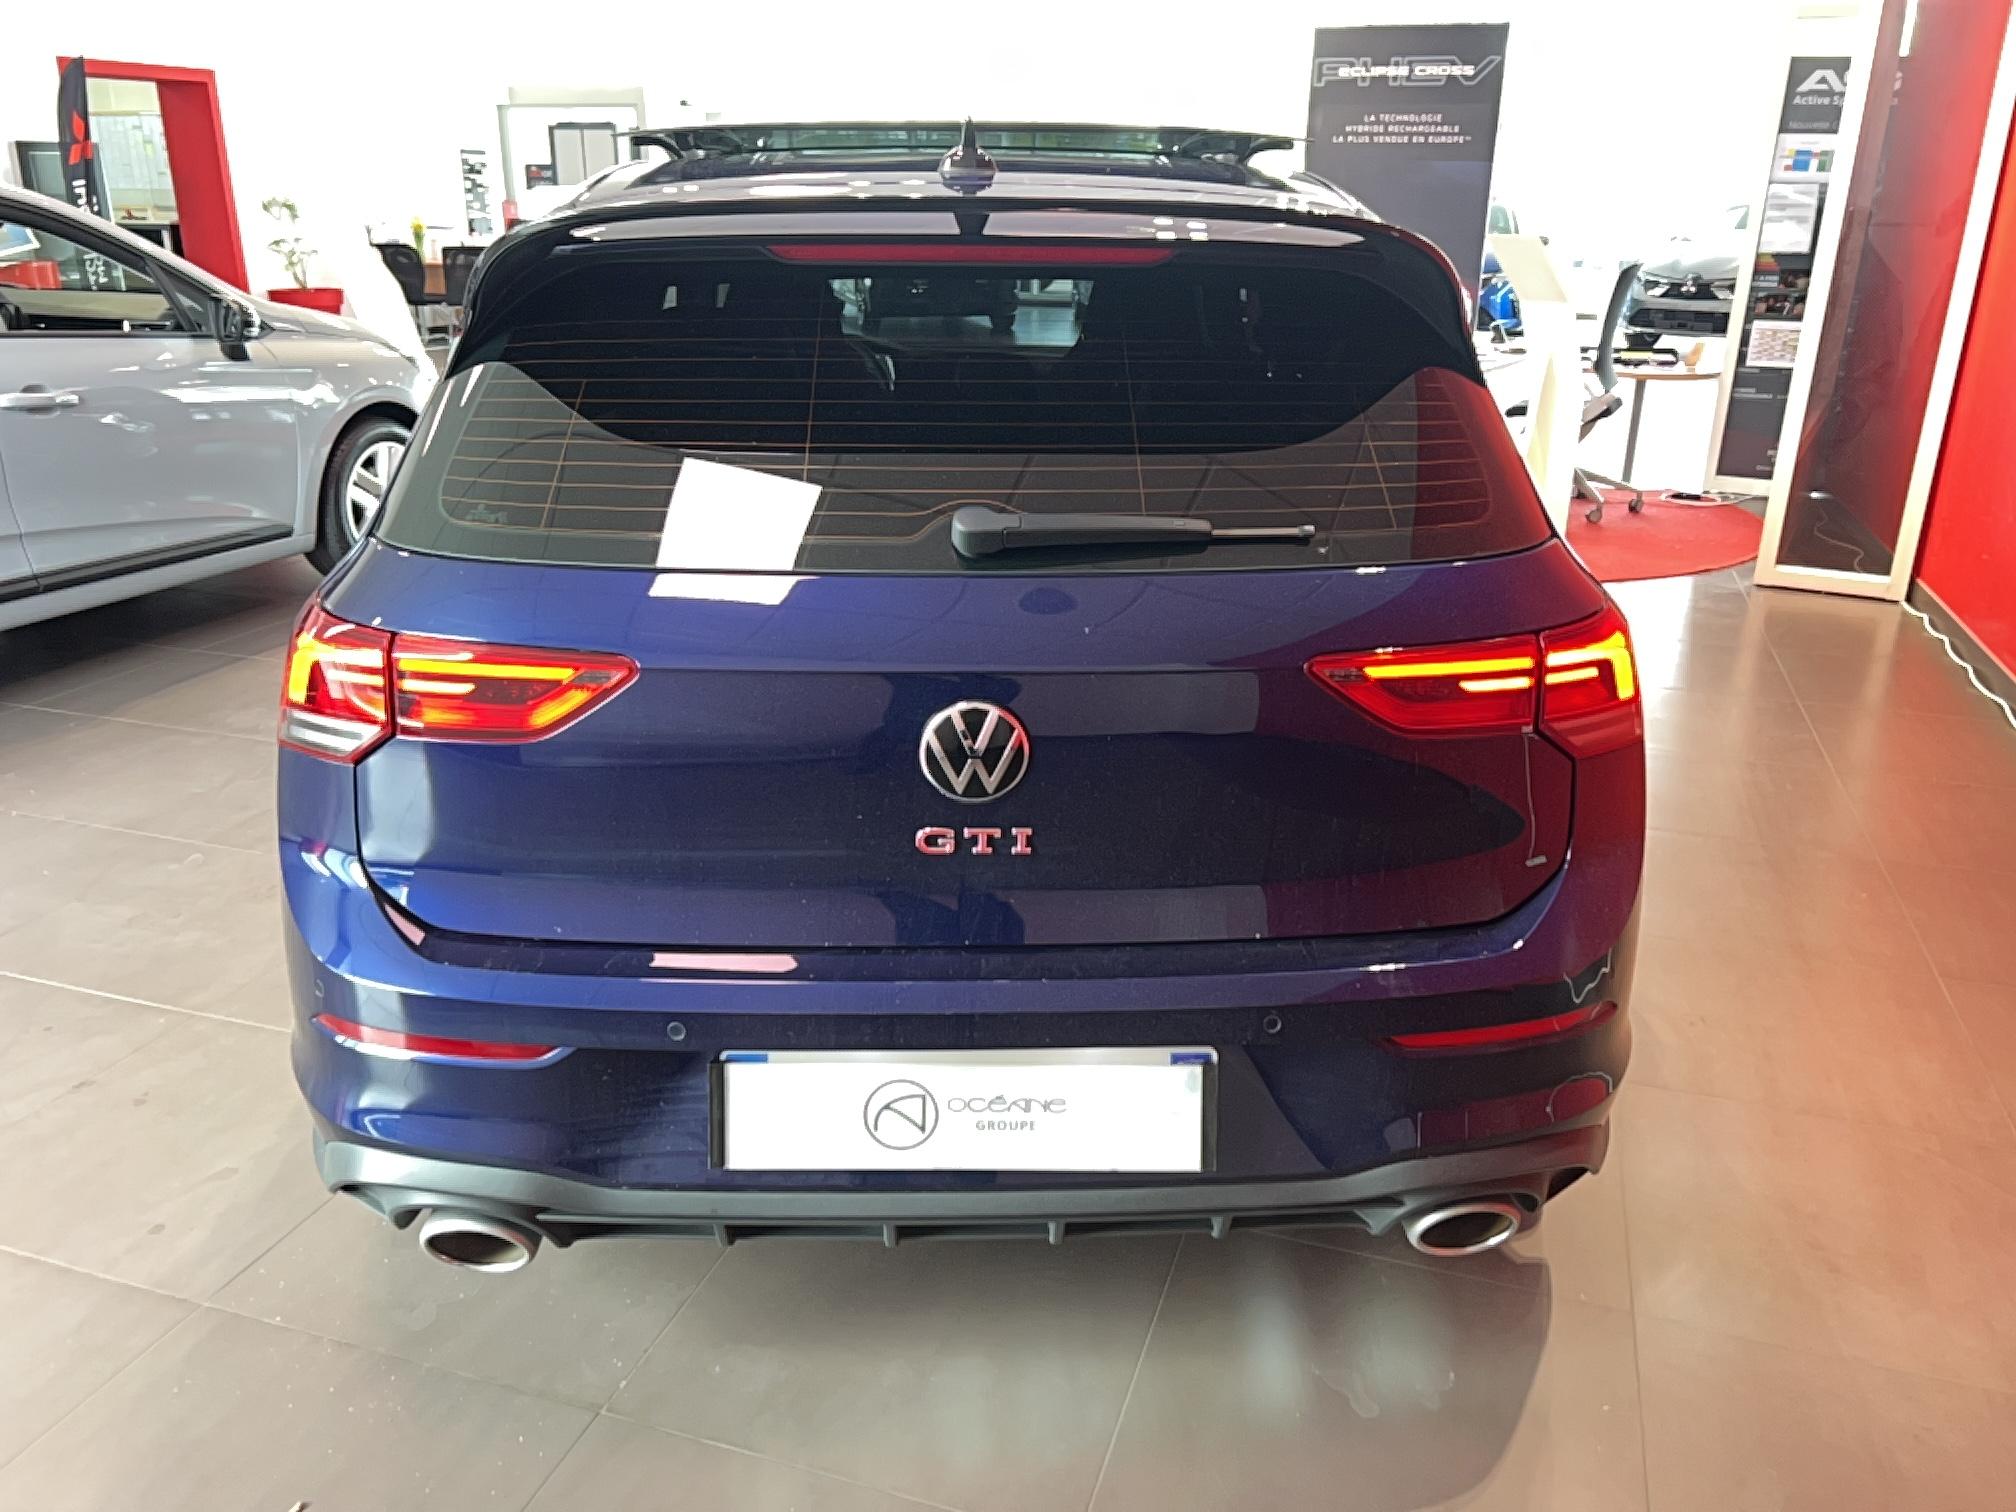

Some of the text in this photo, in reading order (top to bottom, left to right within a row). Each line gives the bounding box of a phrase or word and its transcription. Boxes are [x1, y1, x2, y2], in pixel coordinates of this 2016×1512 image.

[1313, 55, 1502, 87] PHEV
[1338, 64, 1476, 78] ECLIPSE CROSS
[1795, 68, 1847, 93] A
[1793, 95, 1830, 105] Active
[1363, 113, 1442, 122] LA TECHNOLOGIE
[1345, 124, 1460, 133] HYBRIDE RECHARGEABLE
[1332, 135, 1344, 144] LA
[1347, 135, 1370, 144] PLUS
[1373, 135, 1410, 144] VENDUE
[1412, 135, 1425, 143] EN
[915, 826, 1033, 856] GTI
[947, 1094, 1067, 1113] OCÉANE
[976, 1120, 1035, 1131] GROUPE
